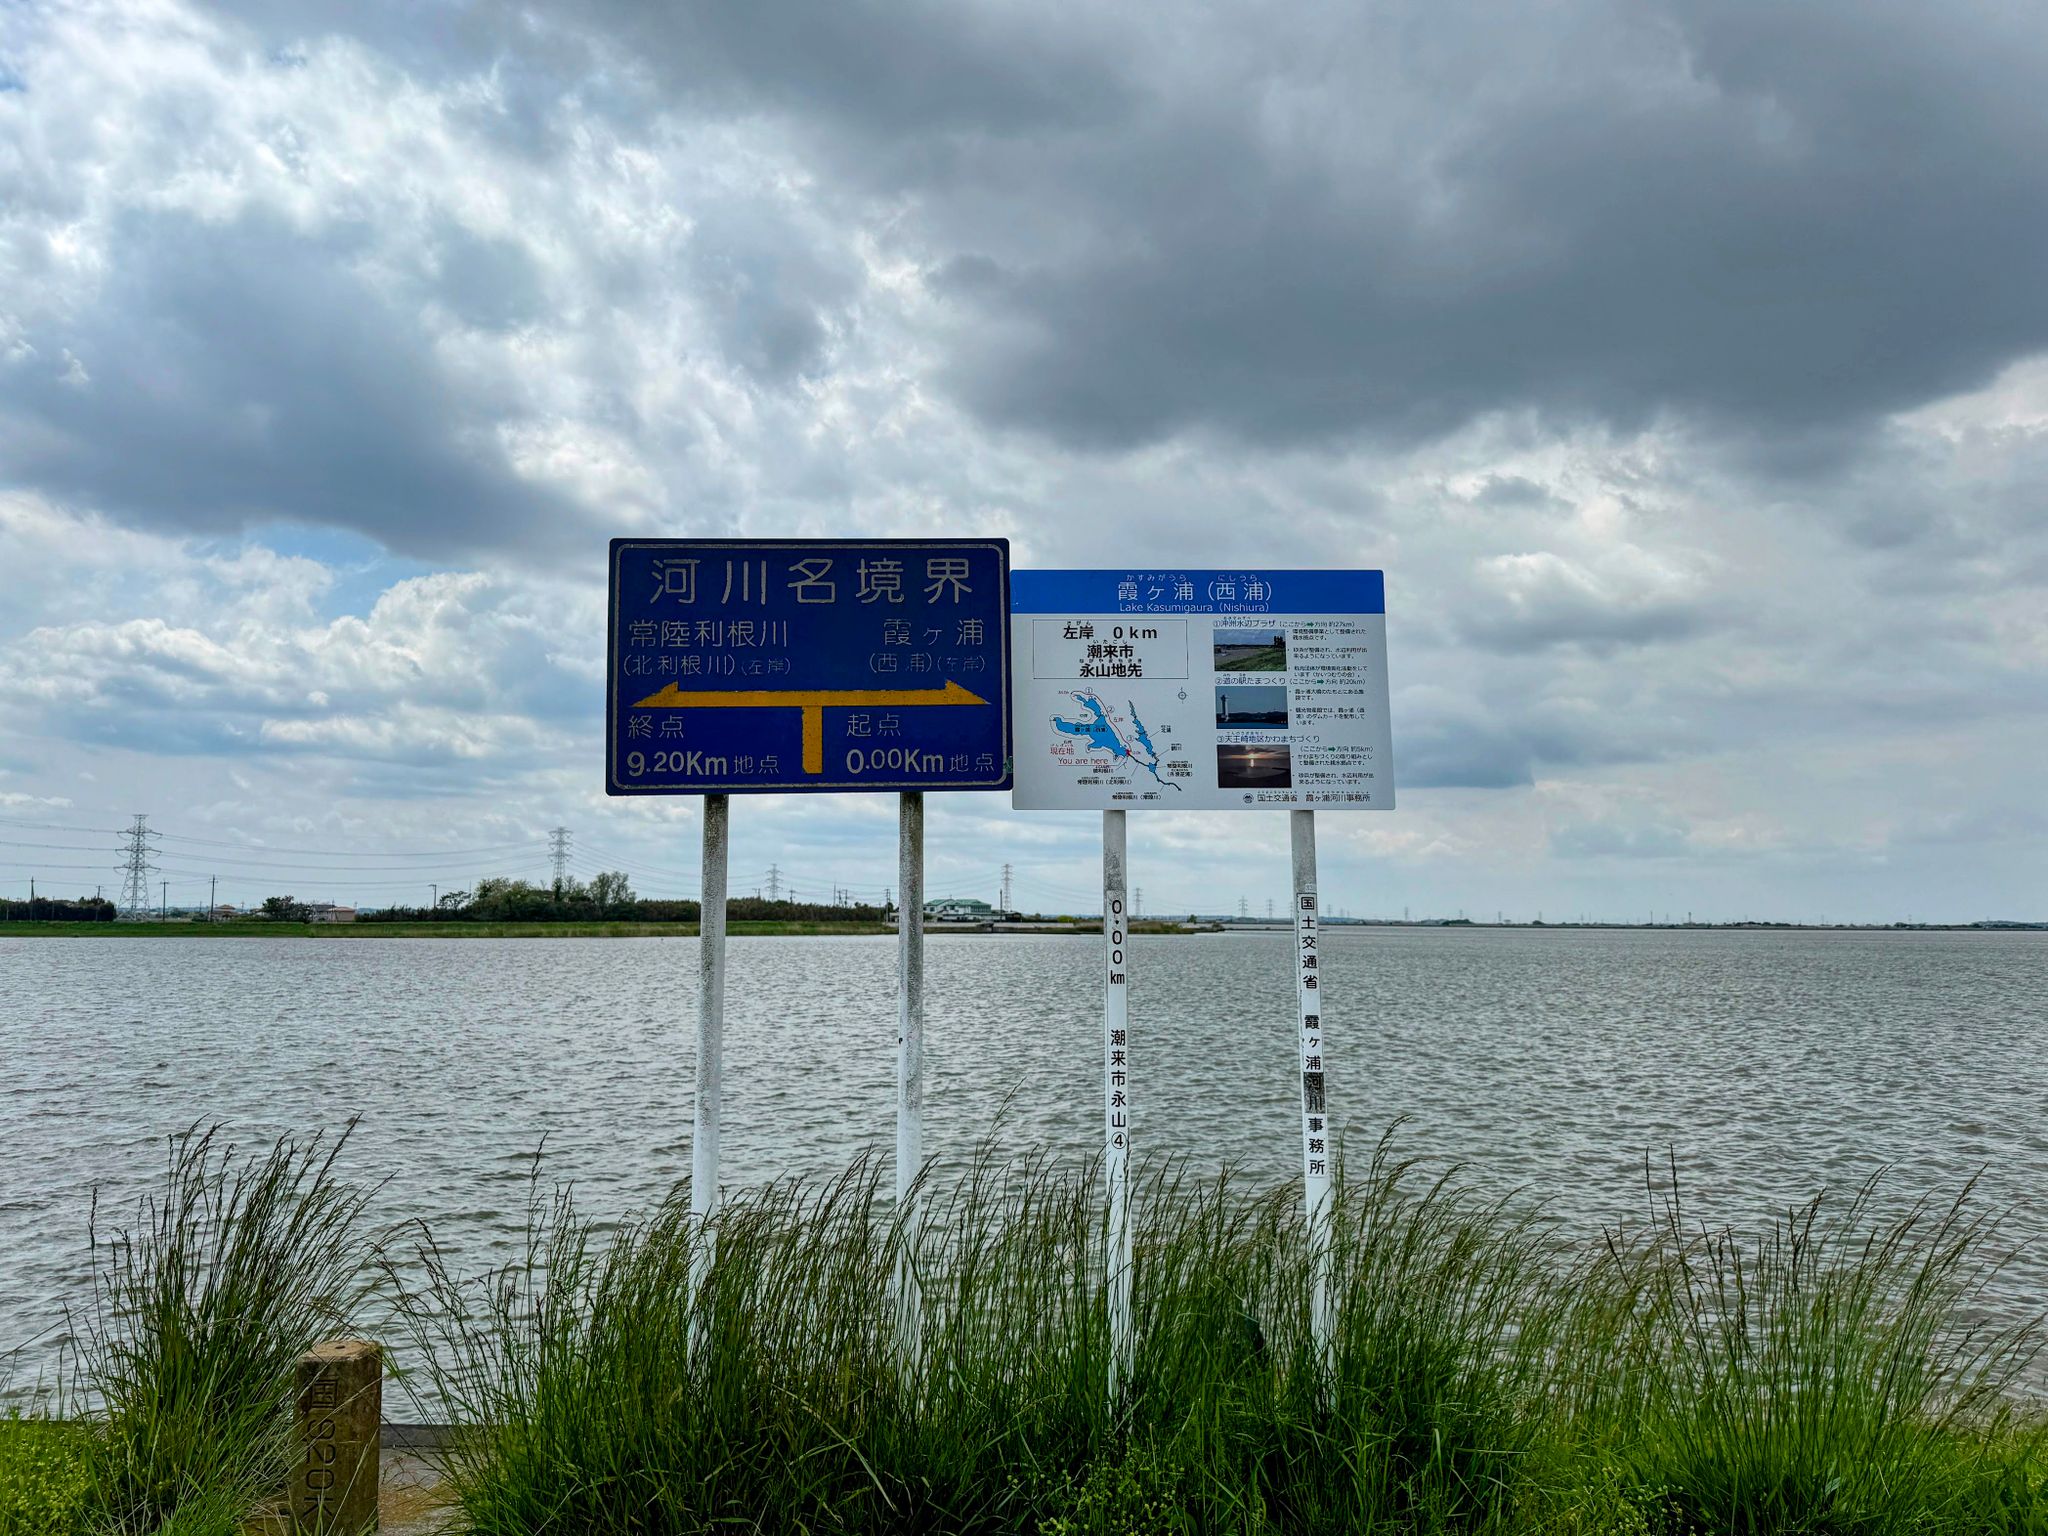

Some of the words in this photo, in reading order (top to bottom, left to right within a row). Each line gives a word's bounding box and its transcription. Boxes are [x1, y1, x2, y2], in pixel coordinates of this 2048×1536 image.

[650, 557, 973, 605] 河川名境界
[1120, 603, 1143, 612] Lake
[1147, 603, 1212, 614] Kasumigaura
[628, 619, 787, 648] 常陸利根川
[882, 618, 984, 647] 霞ヶ浦
[1063, 626, 1094, 640] 左岸
[1087, 644, 1134, 659] 潮来市
[1080, 663, 1143, 678] 永山地先
[628, 715, 685, 739] 終点
[846, 713, 901, 737] 起点
[1058, 757, 1073, 765] You
[1091, 757, 1109, 765] here
[1300, 897, 1318, 991] 国土交通省
[1304, 1014, 1325, 1176] 霞ヶ浦河川事務所
